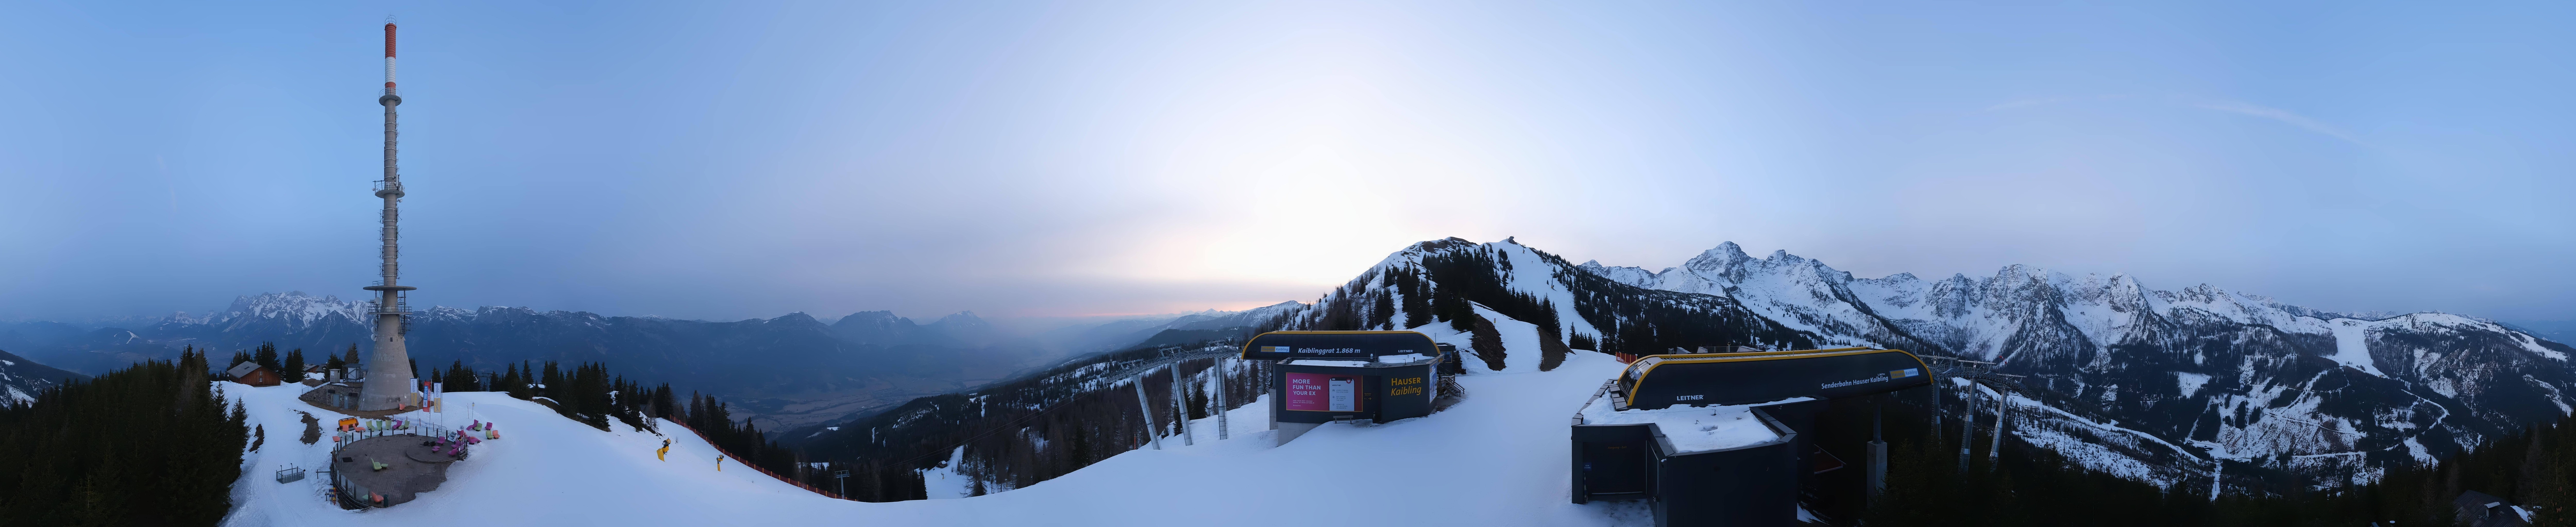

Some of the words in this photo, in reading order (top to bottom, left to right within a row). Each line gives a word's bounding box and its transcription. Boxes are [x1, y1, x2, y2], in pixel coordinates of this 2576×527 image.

[1391, 377, 1421, 386] HAUSER
[1821, 380, 1852, 389] Senderbahn
[1391, 386, 1421, 396] Kaibling
